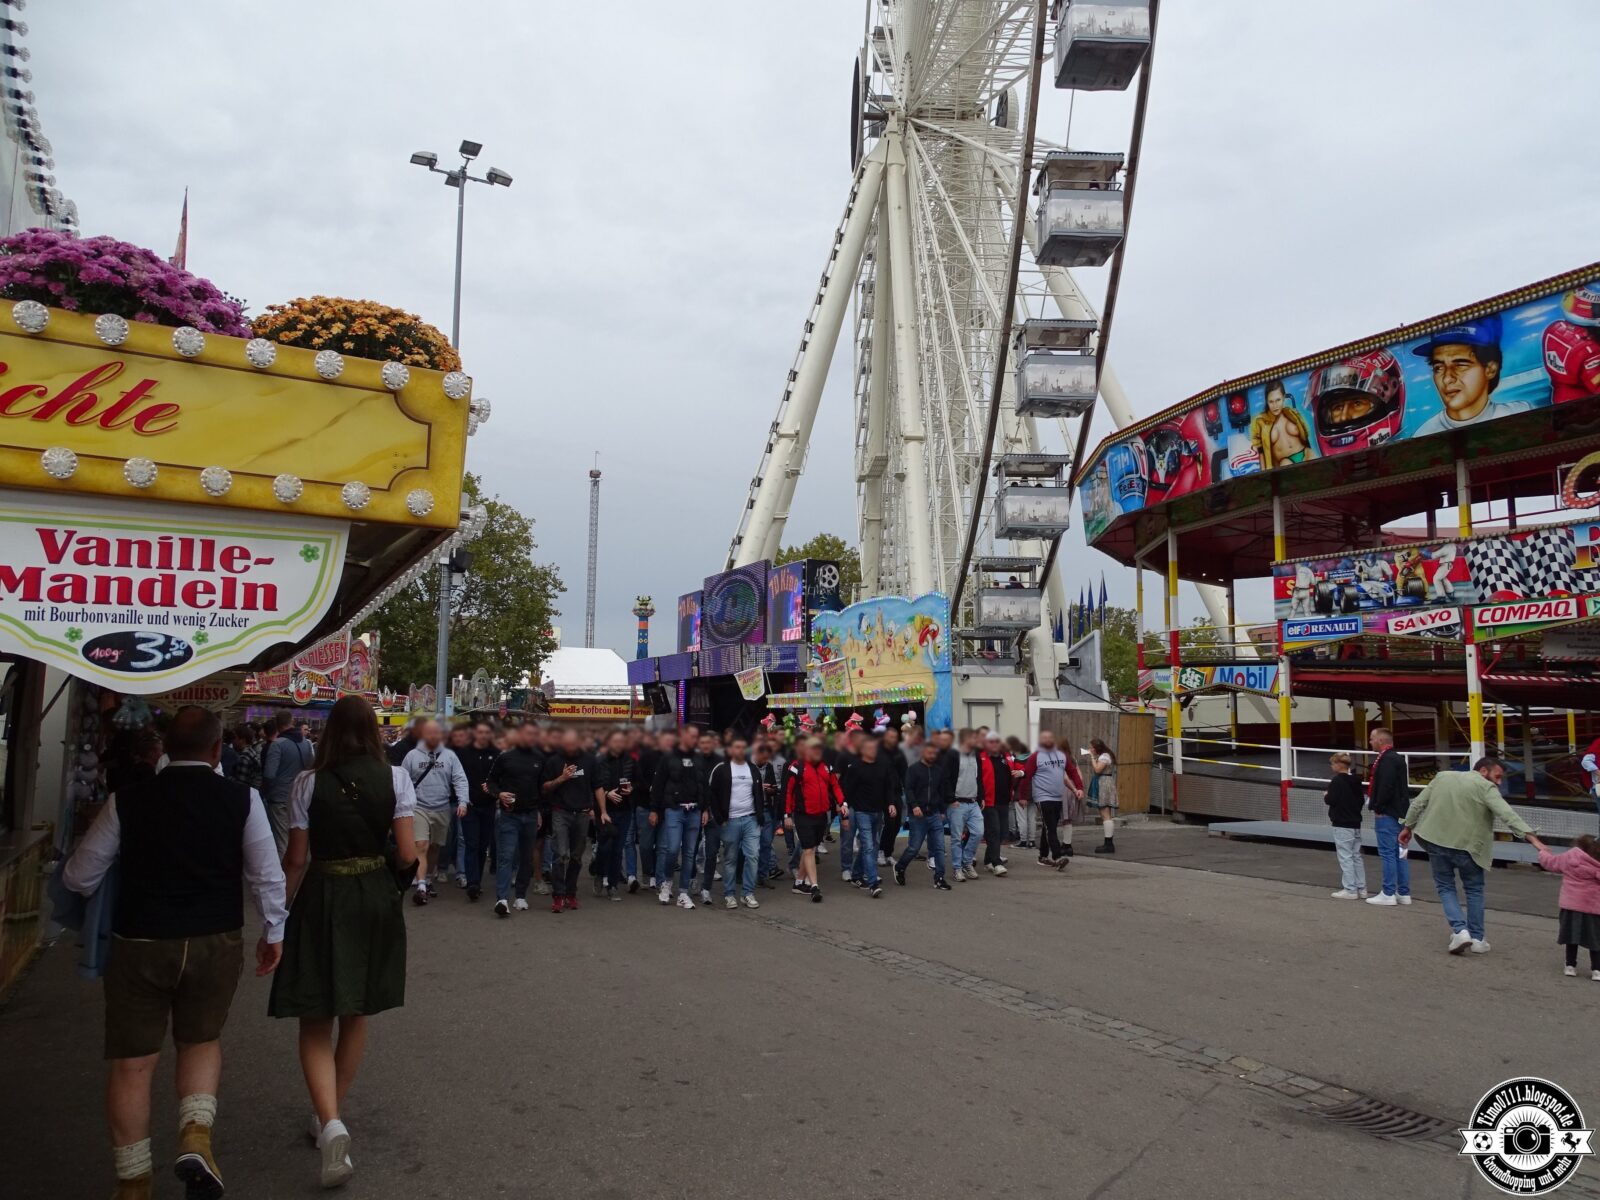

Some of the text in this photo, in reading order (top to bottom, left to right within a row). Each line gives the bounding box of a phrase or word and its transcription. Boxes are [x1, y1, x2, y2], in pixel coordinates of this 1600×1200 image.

[0, 361, 181, 435] chte
[35, 527, 275, 574] Vanille-
[0, 565, 278, 612] Mandeln
[24, 606, 250, 630] mit Bourbonvanille und wenig Zucker
[1393, 609, 1452, 631] SANYO
[1477, 600, 1573, 624] COMPAQ
[1287, 621, 1358, 636] elf RENAULT
[1186, 668, 1202, 681] tic
[1219, 667, 1268, 689] Mobil
